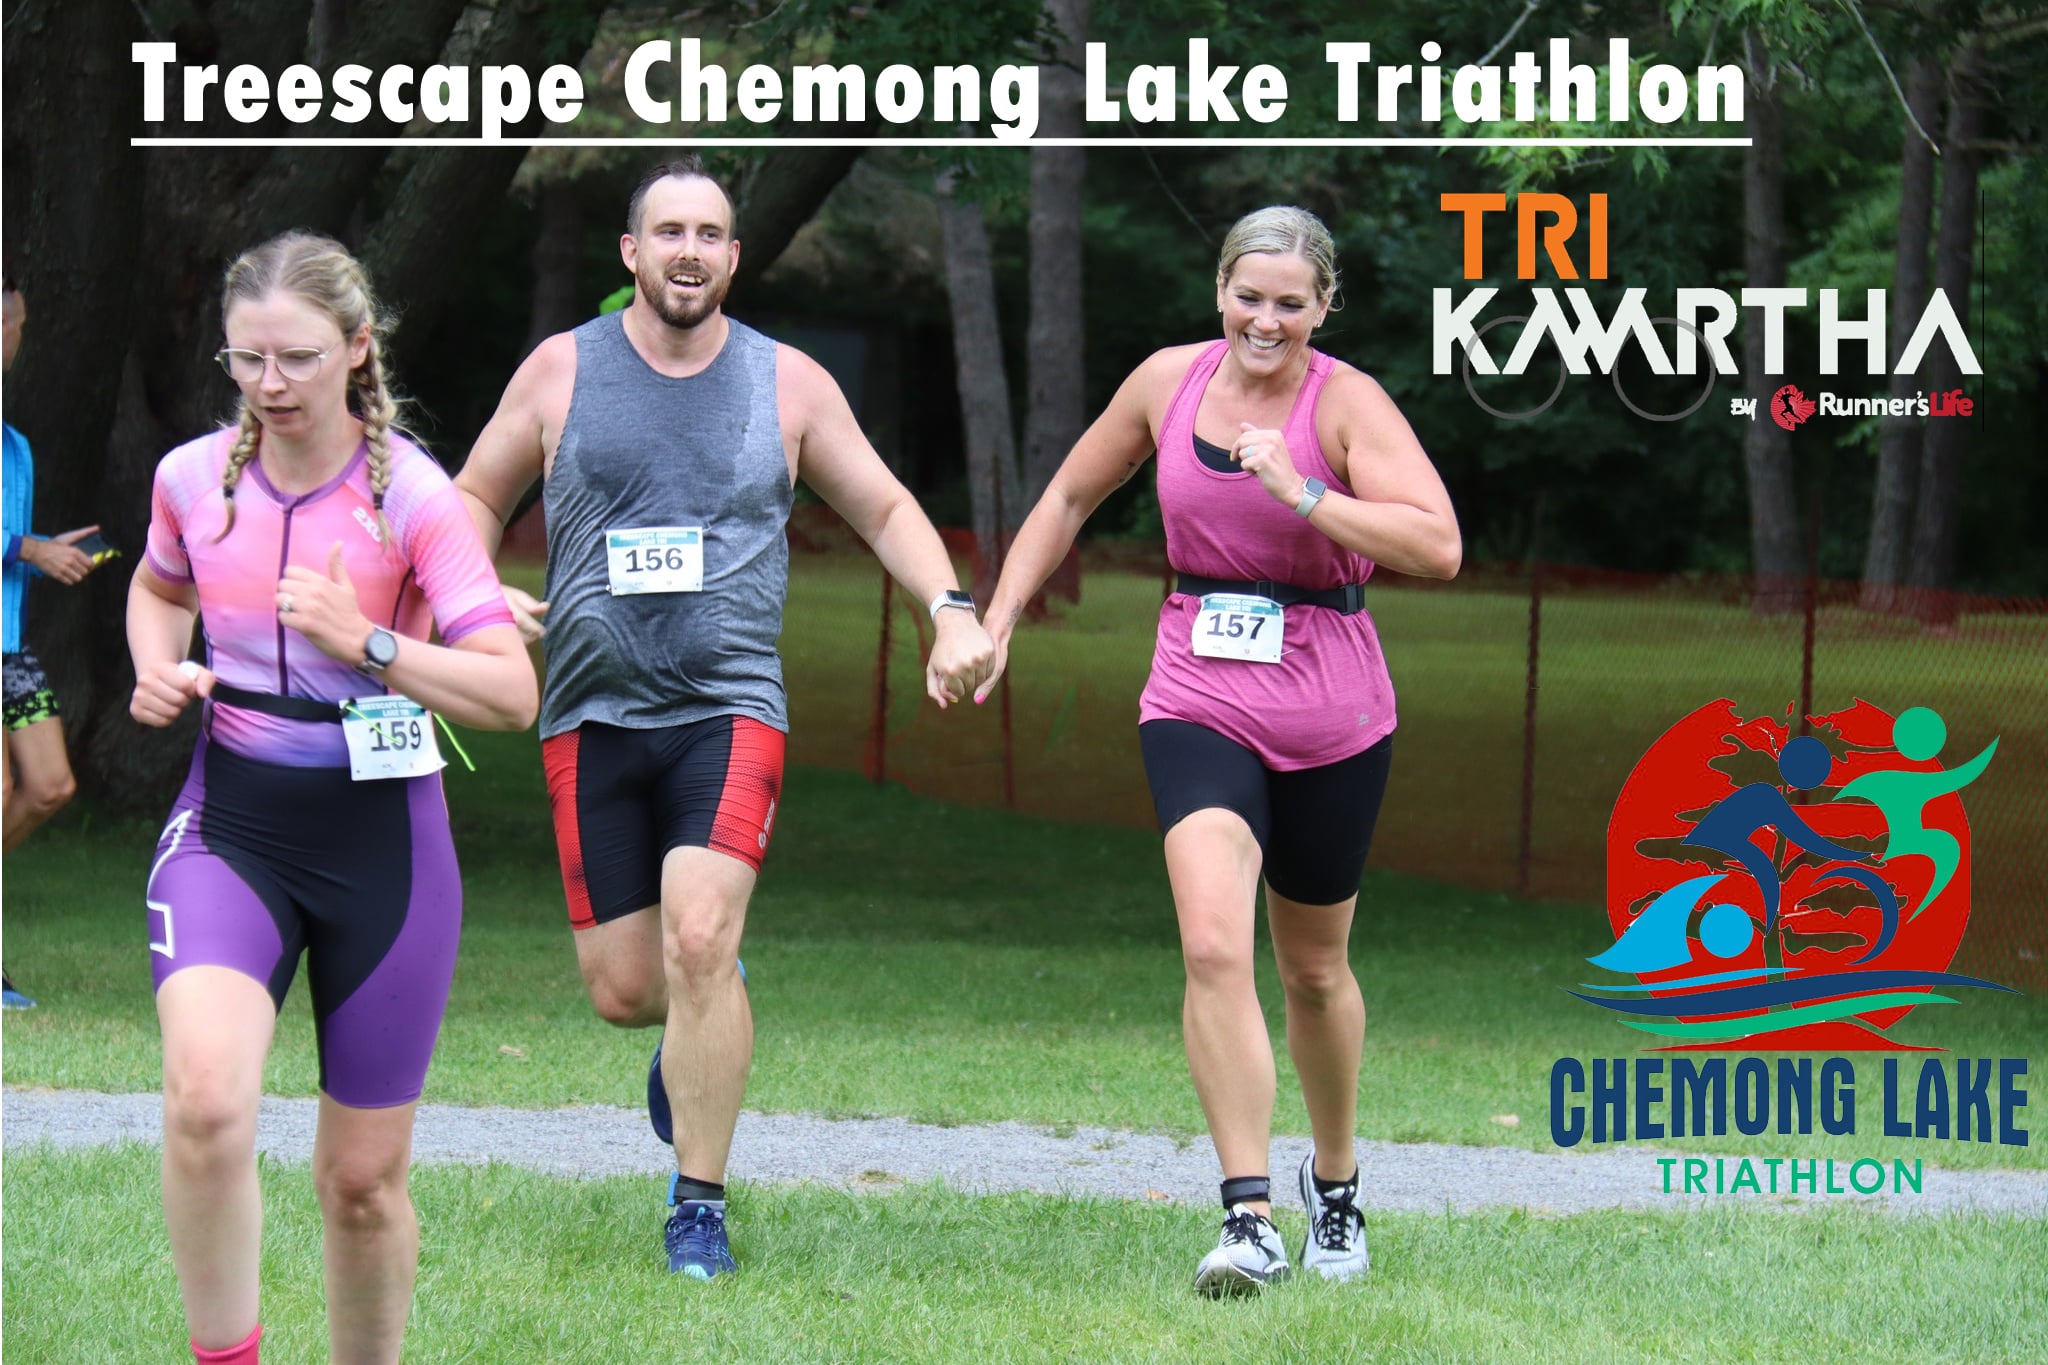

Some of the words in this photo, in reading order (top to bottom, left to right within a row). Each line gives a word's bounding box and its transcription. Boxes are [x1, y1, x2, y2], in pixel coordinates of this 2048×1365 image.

[626, 547, 683, 573] 156
[1207, 613, 1265, 640] 157
[369, 720, 421, 752] 159
